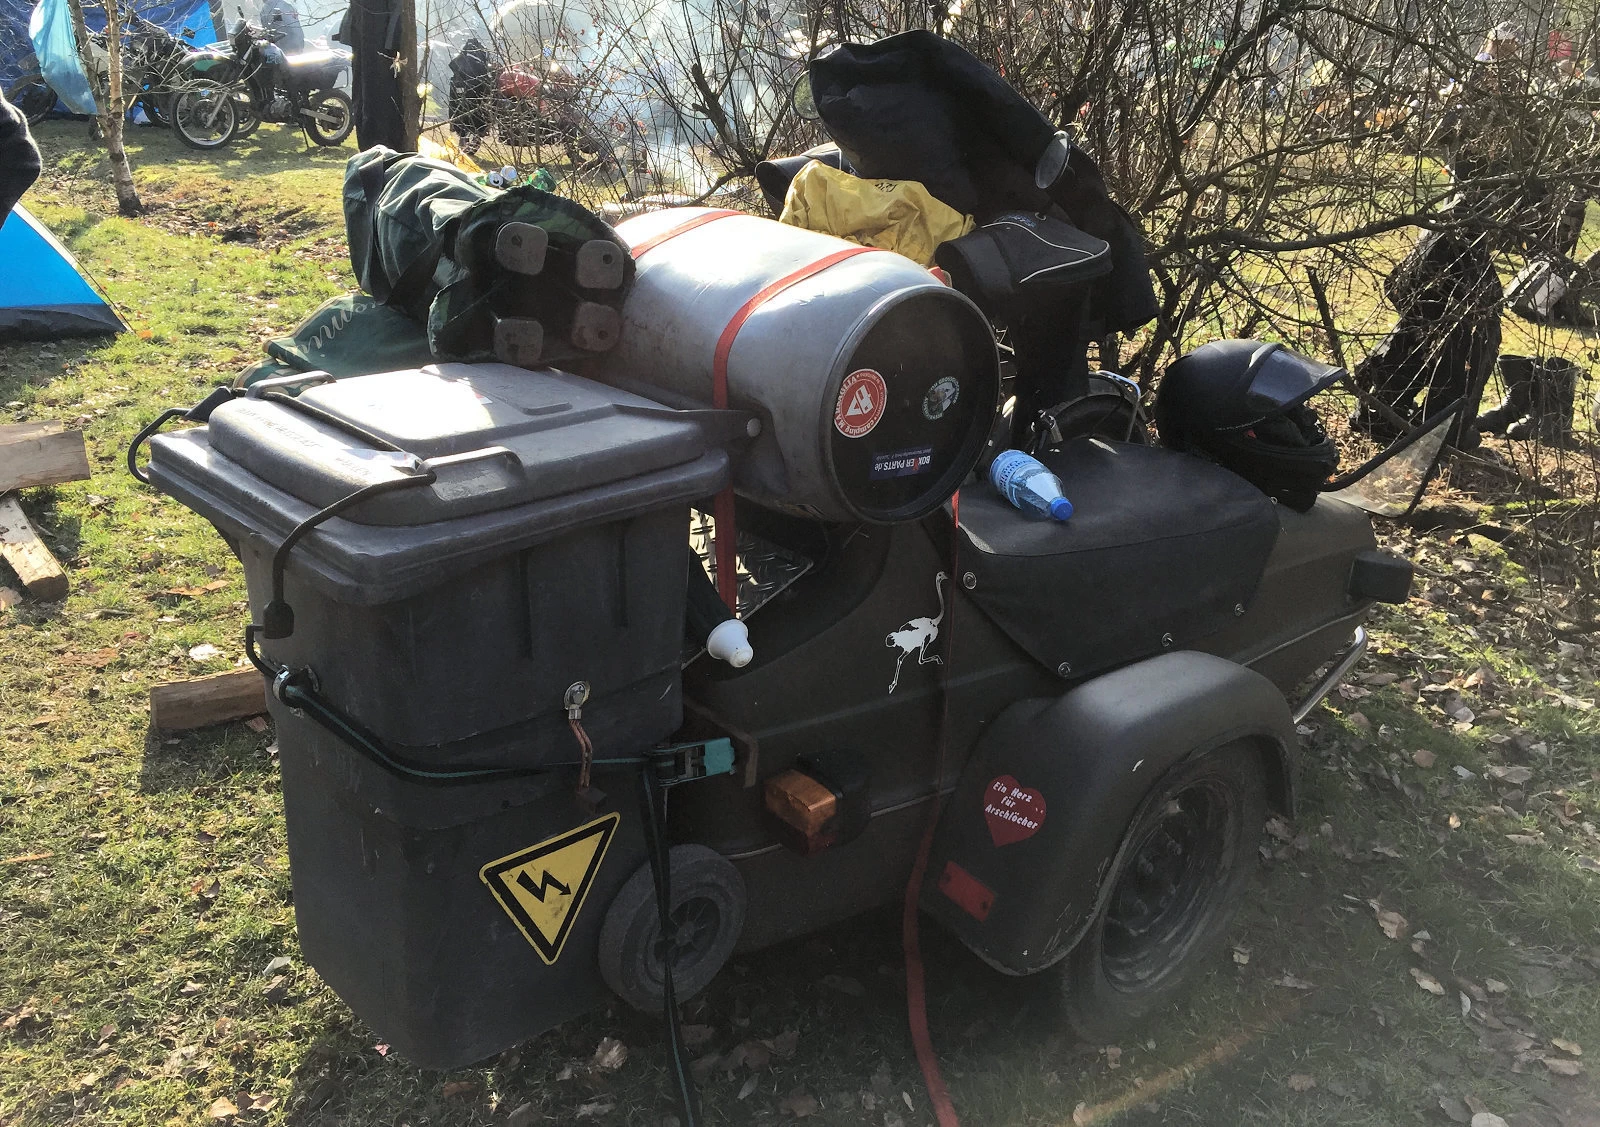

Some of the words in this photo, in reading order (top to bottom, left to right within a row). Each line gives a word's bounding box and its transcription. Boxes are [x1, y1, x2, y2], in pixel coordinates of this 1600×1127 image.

[844, 419, 875, 436] camping
[874, 459, 905, 472] PARTS.de
[992, 781, 1008, 794] Ein
[1010, 787, 1033, 803] Herz
[1000, 796, 1017, 808] für
[984, 803, 1039, 829] Arschlöcher
